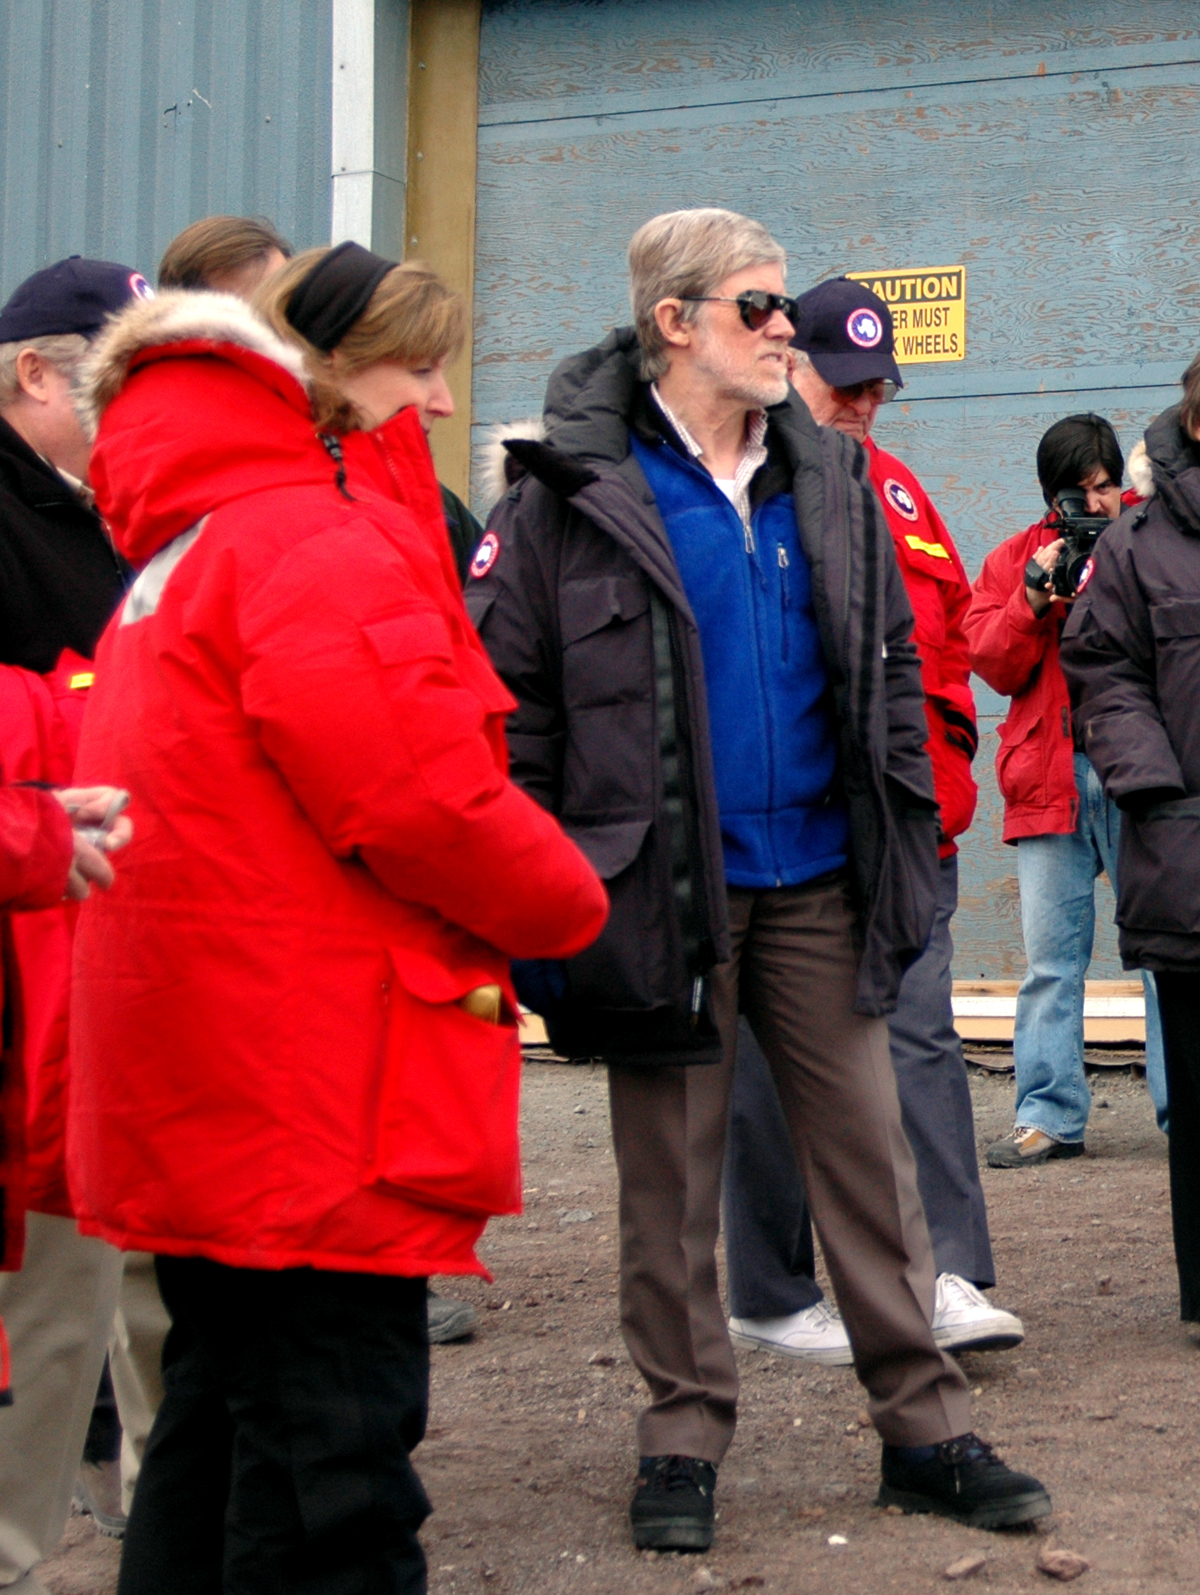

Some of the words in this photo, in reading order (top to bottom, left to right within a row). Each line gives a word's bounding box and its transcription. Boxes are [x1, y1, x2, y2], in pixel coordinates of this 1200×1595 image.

[859, 275, 958, 302] AUTION
[912, 306, 950, 328] MUST
[902, 333, 958, 356] WHEELS
